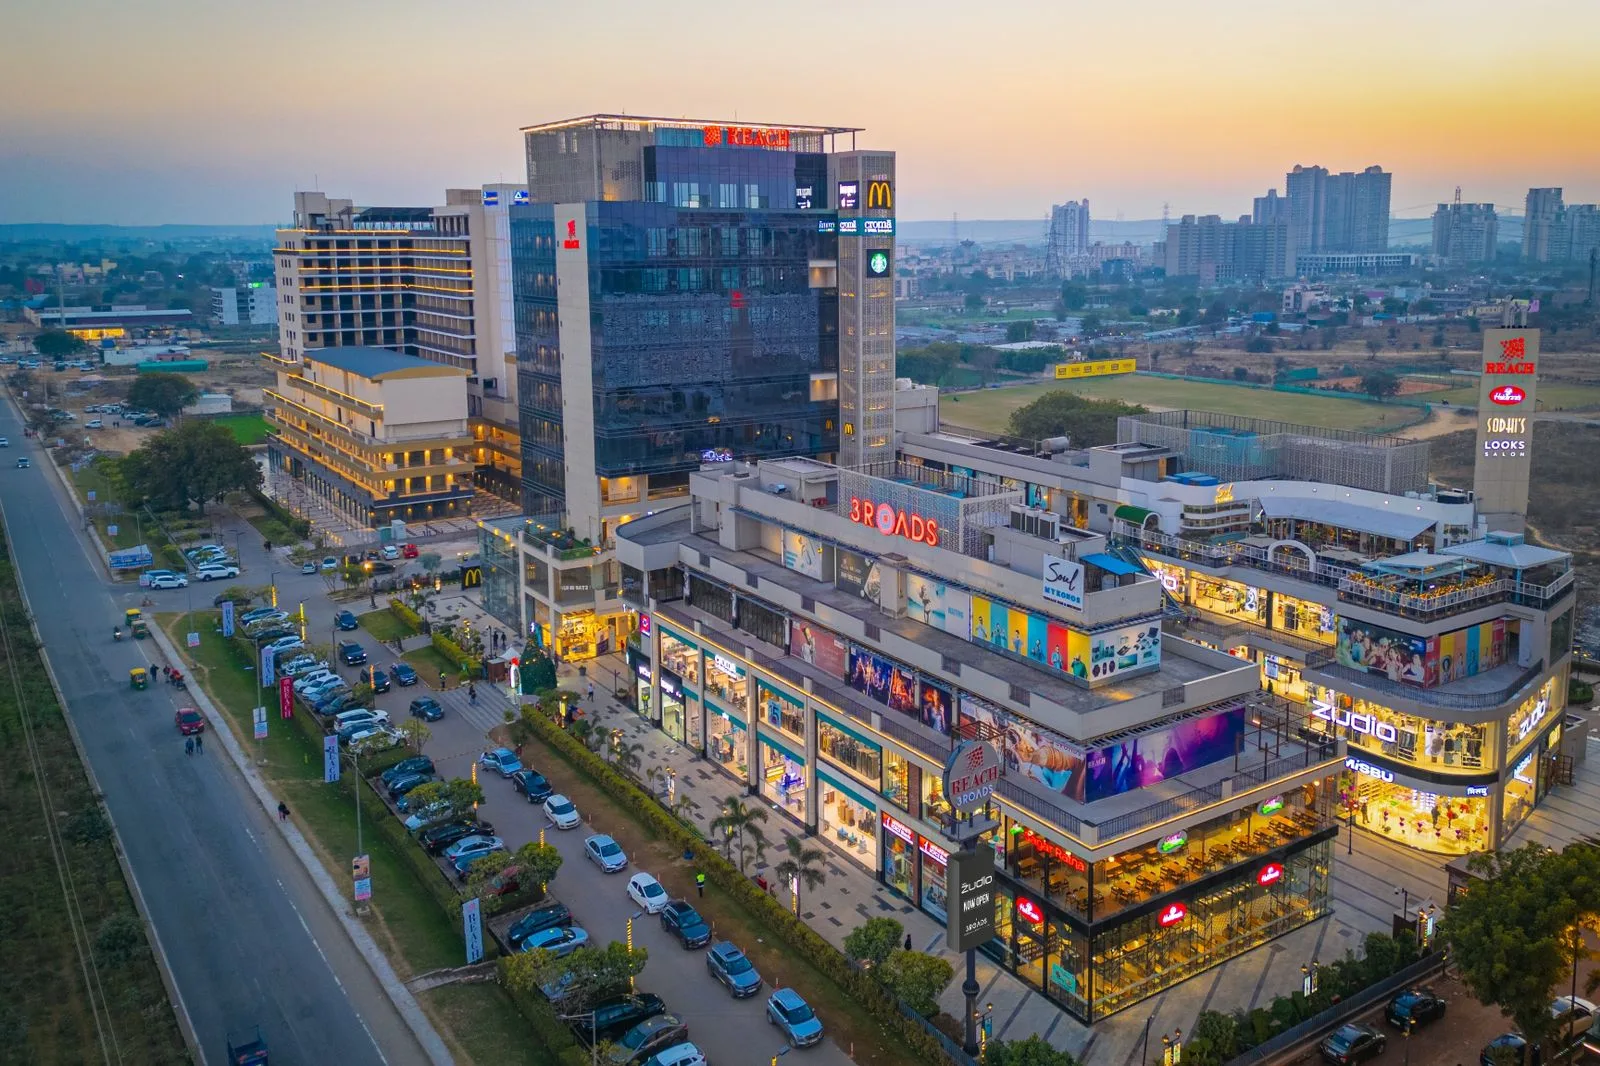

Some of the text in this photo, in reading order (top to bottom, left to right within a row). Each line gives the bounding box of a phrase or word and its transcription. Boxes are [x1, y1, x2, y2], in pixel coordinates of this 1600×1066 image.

[727, 126, 789, 147] REACH
[1485, 362, 1535, 375] REACH
[1487, 417, 1526, 434] SODHI'S
[1484, 440, 1526, 450] LOOKS
[850, 496, 939, 546] 3ROADS
[1045, 562, 1079, 591] Soul
[1044, 586, 1081, 604] MYKONOS
[952, 765, 999, 796] REACH
[957, 784, 994, 807] 3ROADS
[963, 892, 990, 912] NOW OPEN
